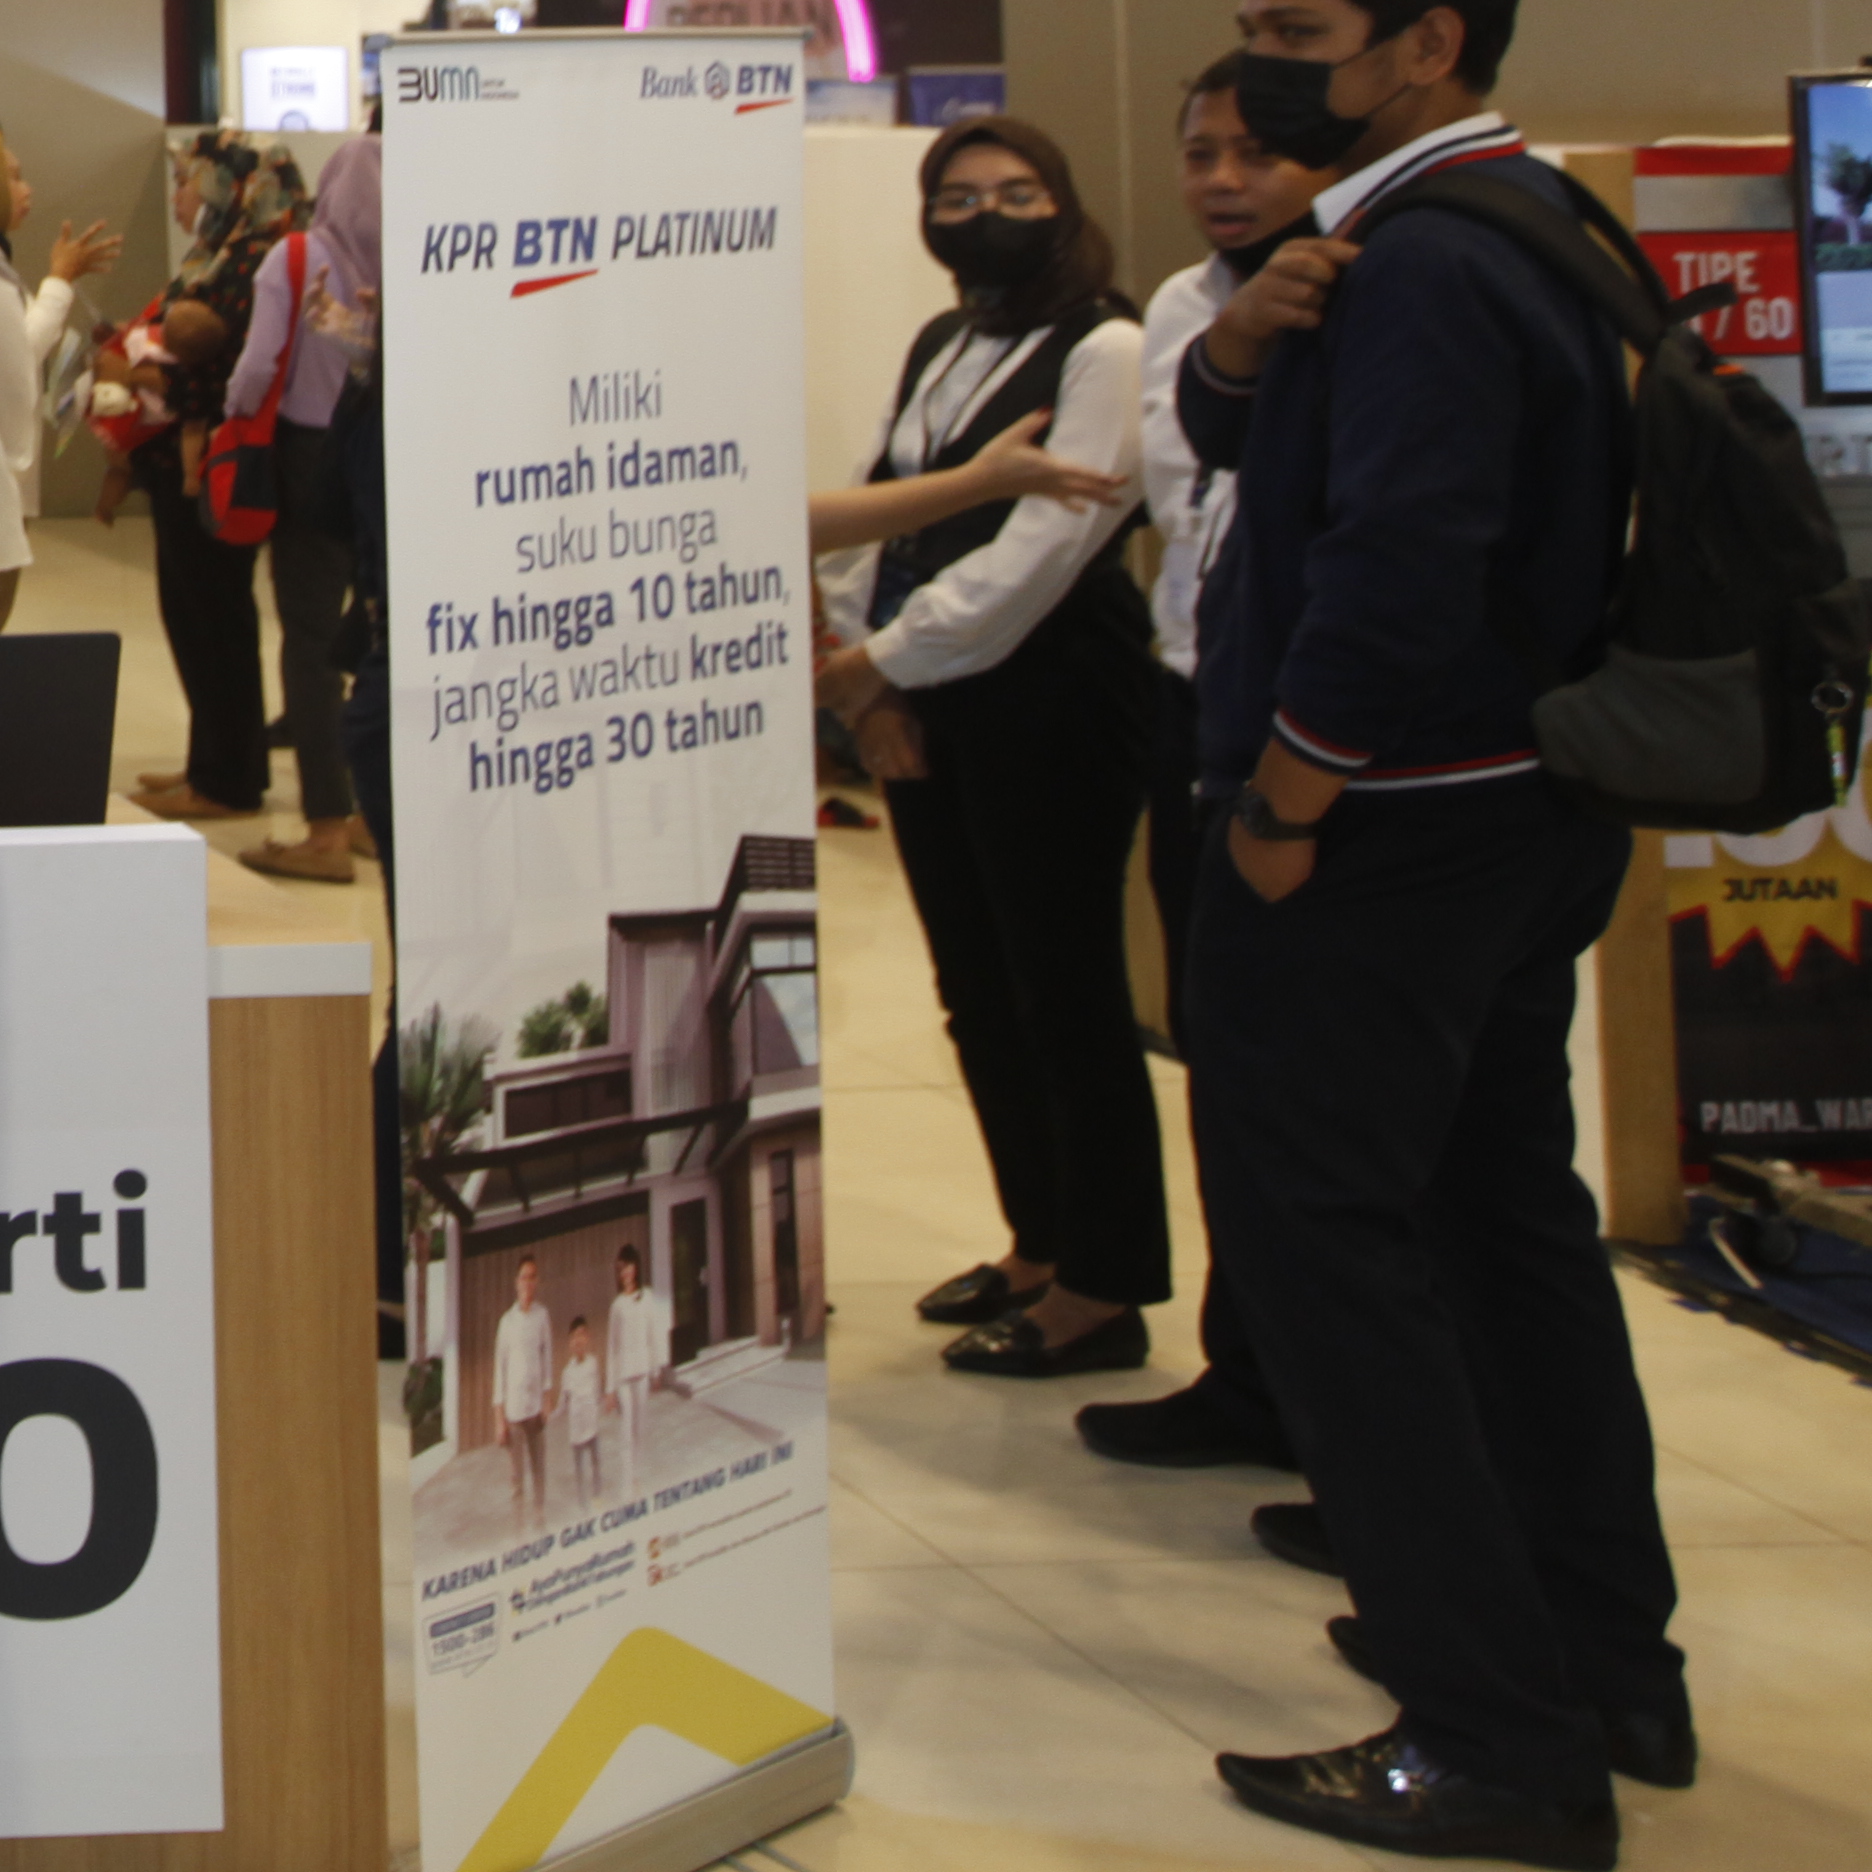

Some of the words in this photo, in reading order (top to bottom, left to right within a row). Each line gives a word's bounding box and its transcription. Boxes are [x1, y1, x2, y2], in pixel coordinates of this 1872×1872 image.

[640, 65, 700, 99] Bank
[736, 63, 794, 95] BTN
[421, 222, 498, 274] KPR
[512, 215, 598, 267] BTN
[611, 205, 778, 261] PLATINUM
[1673, 250, 1762, 293] TIPE
[1744, 297, 1795, 341] 60
[569, 369, 662, 428] Miliki
[475, 444, 595, 509] rumah
[607, 438, 749, 492] idaman,
[516, 516, 597, 574] suku
[609, 507, 719, 565] bunga
[426, 602, 480, 656] fix
[492, 590, 615, 652] hingga
[629, 571, 676, 624] 10
[685, 560, 792, 616] tahun,
[430, 663, 560, 742] jangka
[569, 643, 680, 704] waktu
[689, 619, 790, 682] kredit
[469, 731, 594, 795] hingga
[606, 711, 655, 765] 30
[665, 697, 764, 754] tahun
[1722, 877, 1838, 903] JUTAAN
[421, 1556, 498, 1602] KARENA
[502, 1533, 555, 1573] HIDUP
[559, 1515, 597, 1549] GAK
[600, 1498, 649, 1533] CUMA
[653, 1467, 726, 1509] TENTANG
[729, 1448, 770, 1482] HARI
